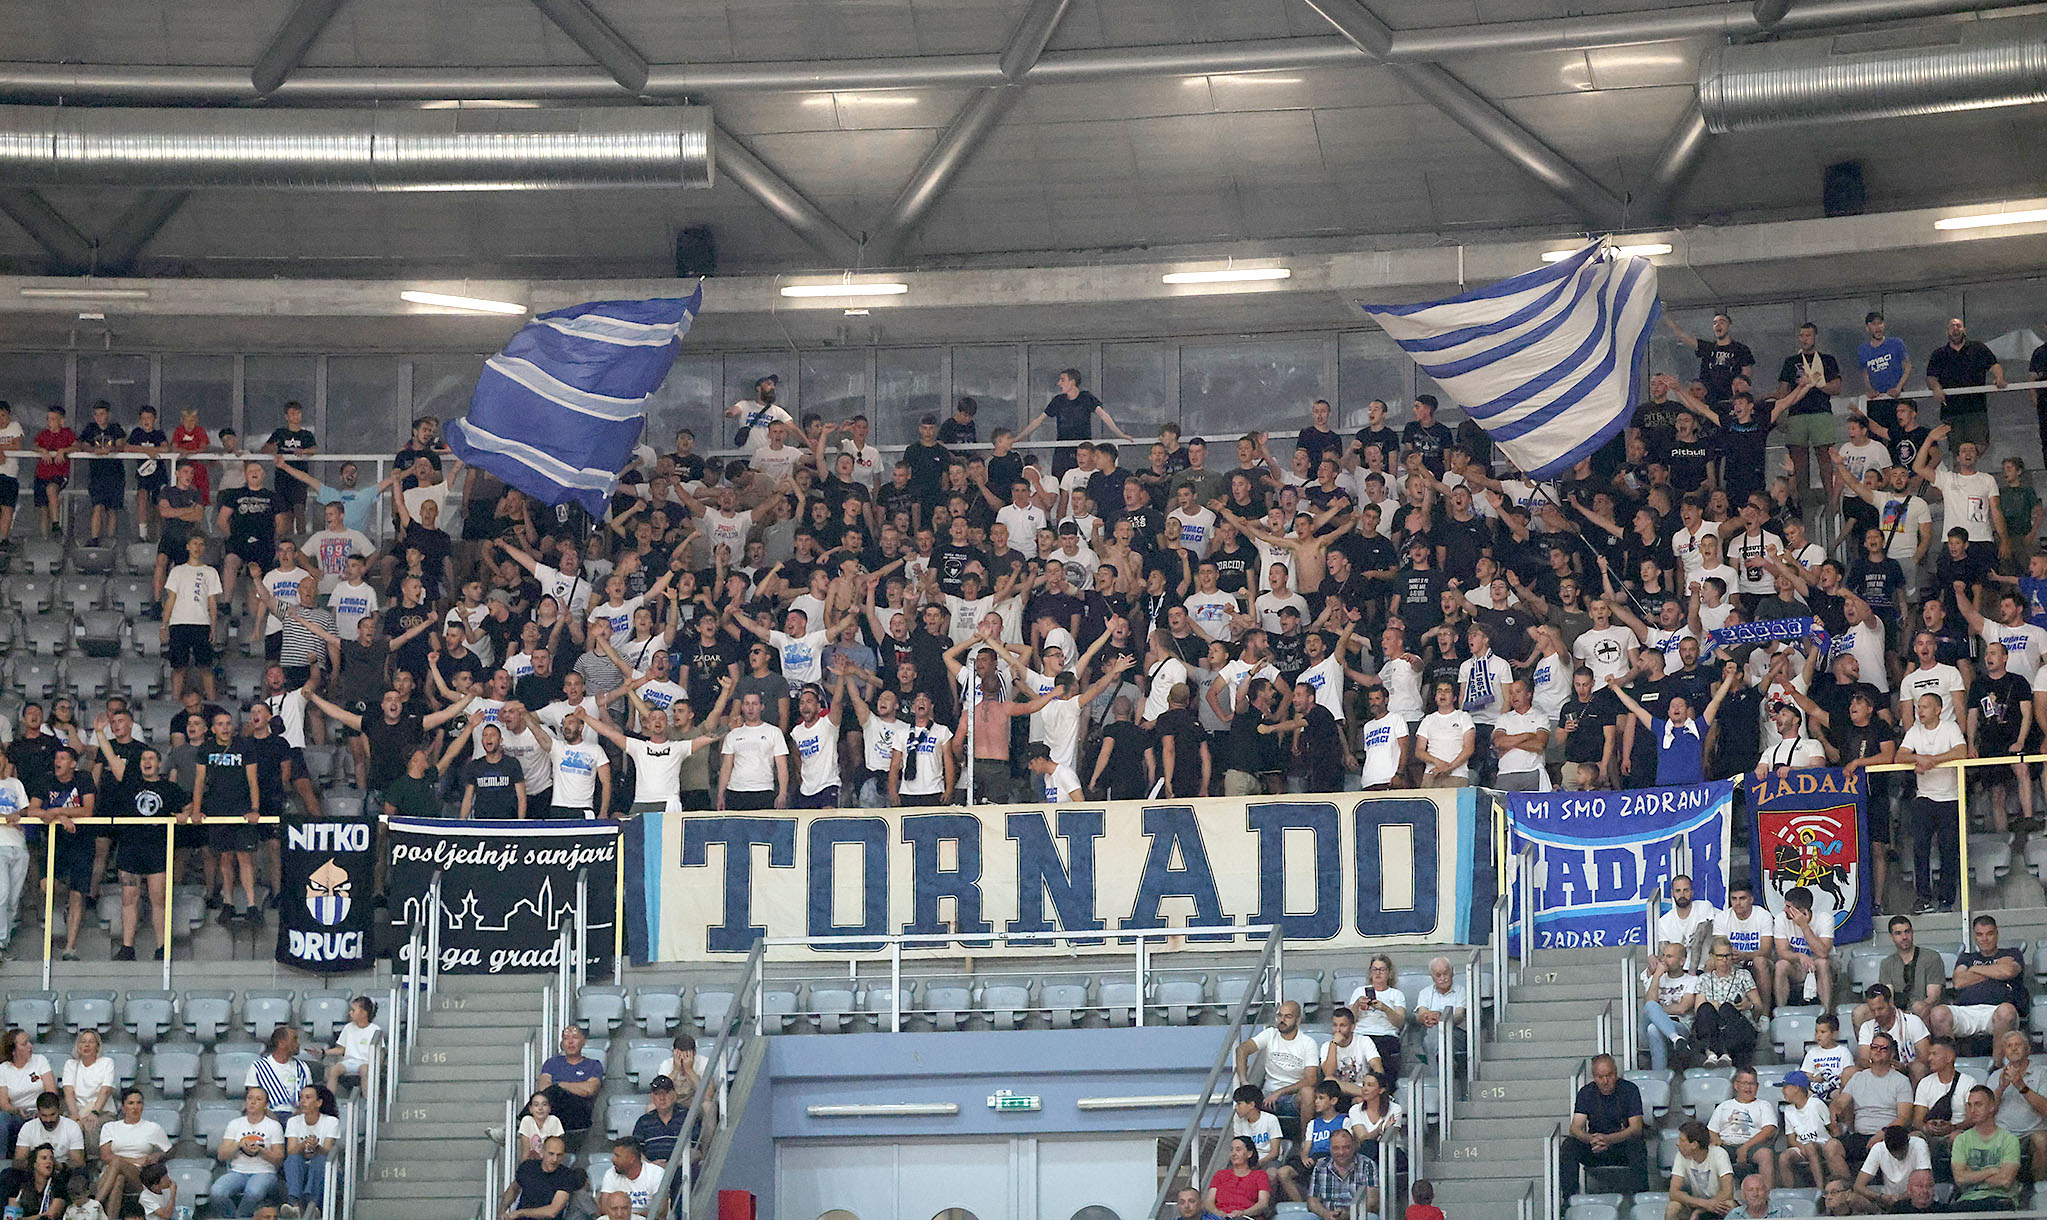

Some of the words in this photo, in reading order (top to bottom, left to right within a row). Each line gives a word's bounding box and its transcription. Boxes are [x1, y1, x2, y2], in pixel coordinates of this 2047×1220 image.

[1671, 448, 1706, 457] Pitbull
[193, 572, 204, 602] PARIS
[693, 654, 721, 663] ZADAR
[1561, 798, 1606, 821] SMO
[1619, 788, 1710, 818] ZADRANI
[1751, 773, 1859, 806] ZADAR
[288, 823, 370, 852] NITKO
[391, 839, 519, 871] posljednji
[523, 841, 616, 872] sanjari
[679, 796, 1441, 953] TORNADO
[288, 928, 364, 961] DRUGI
[1540, 929, 1606, 949] ZADAR
[1617, 926, 1642, 946] JE
[1313, 1130, 1331, 1143] ZAD
